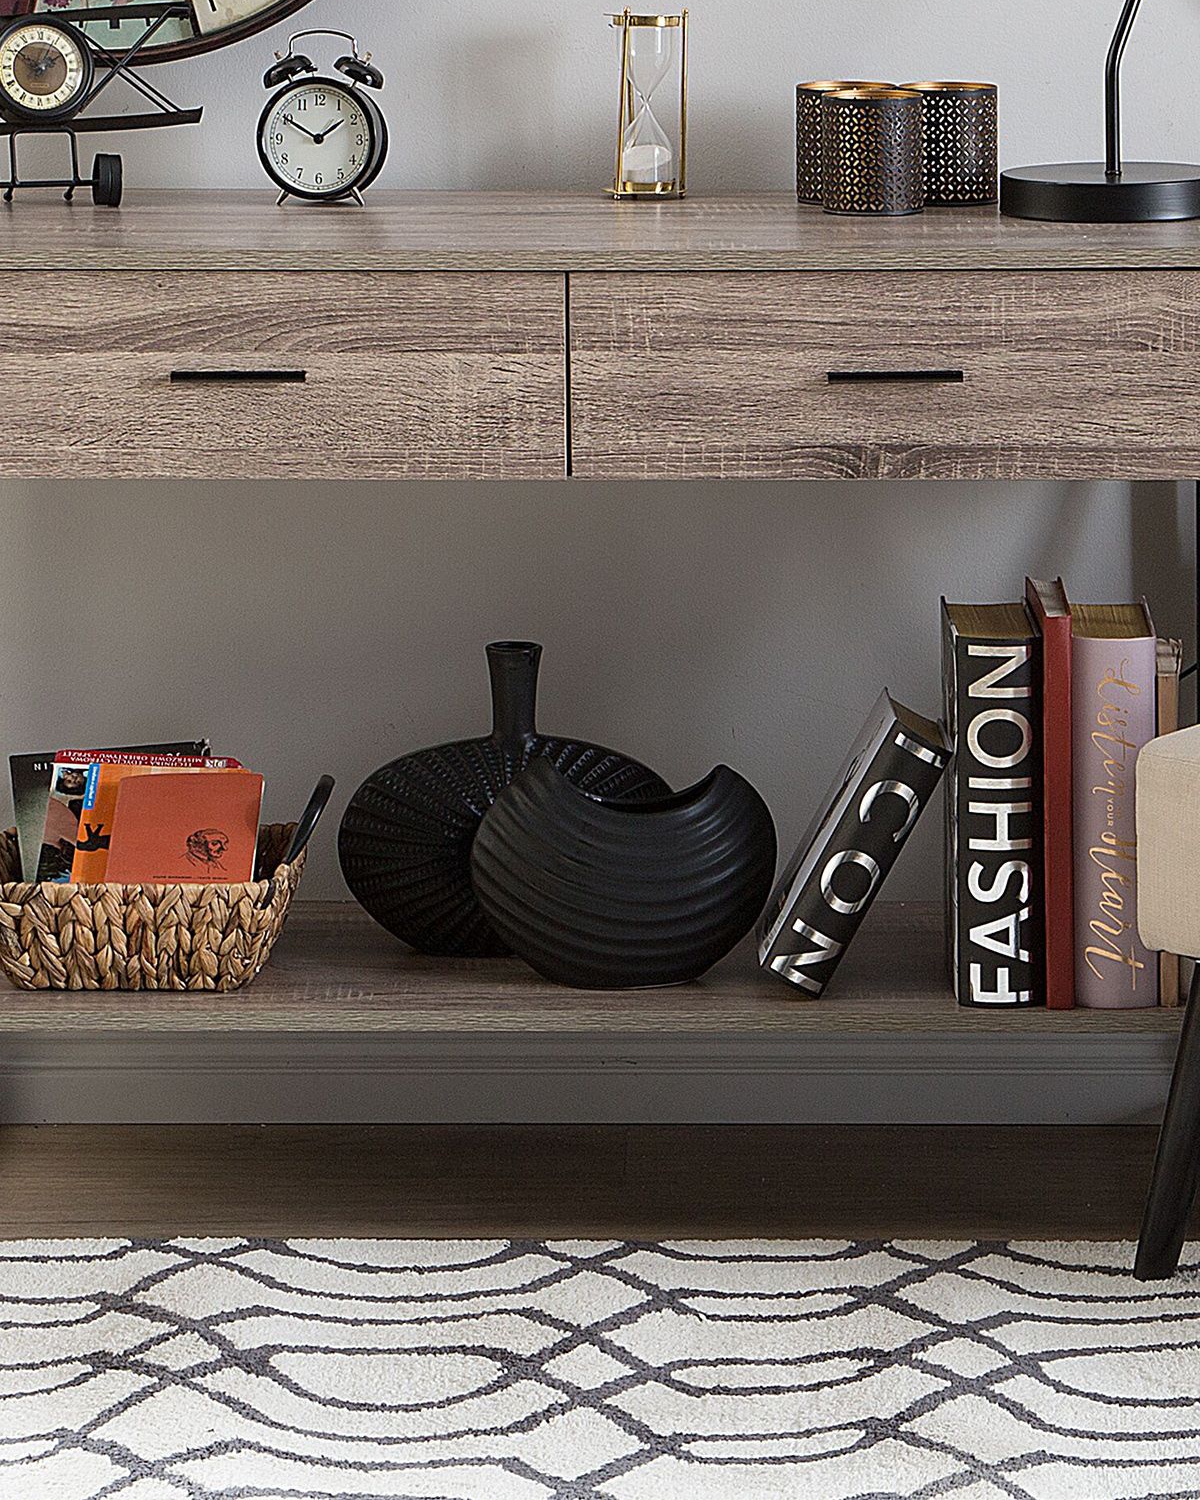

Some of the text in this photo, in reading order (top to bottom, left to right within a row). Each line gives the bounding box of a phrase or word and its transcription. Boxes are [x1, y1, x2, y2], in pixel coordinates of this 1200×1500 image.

[297, 99, 307, 111] 11
[314, 94, 326, 106] 12
[336, 99, 341, 111] 1
[350, 113, 358, 125] 2
[275, 133, 283, 145] 9
[356, 134, 363, 146] 3
[281, 153, 289, 165] 8
[349, 154, 357, 166] 4
[296, 167, 303, 179] 7
[315, 172, 323, 184] 6
[337, 168, 344, 180] 5
[99, 752, 148, 761] OBIEKTYWU
[151, 756, 202, 764] MISTRZOWIE
[968, 644, 1032, 1004] FASHION
[1085, 658, 1144, 991] Listen YOUR Heart
[770, 731, 949, 994] ICON
